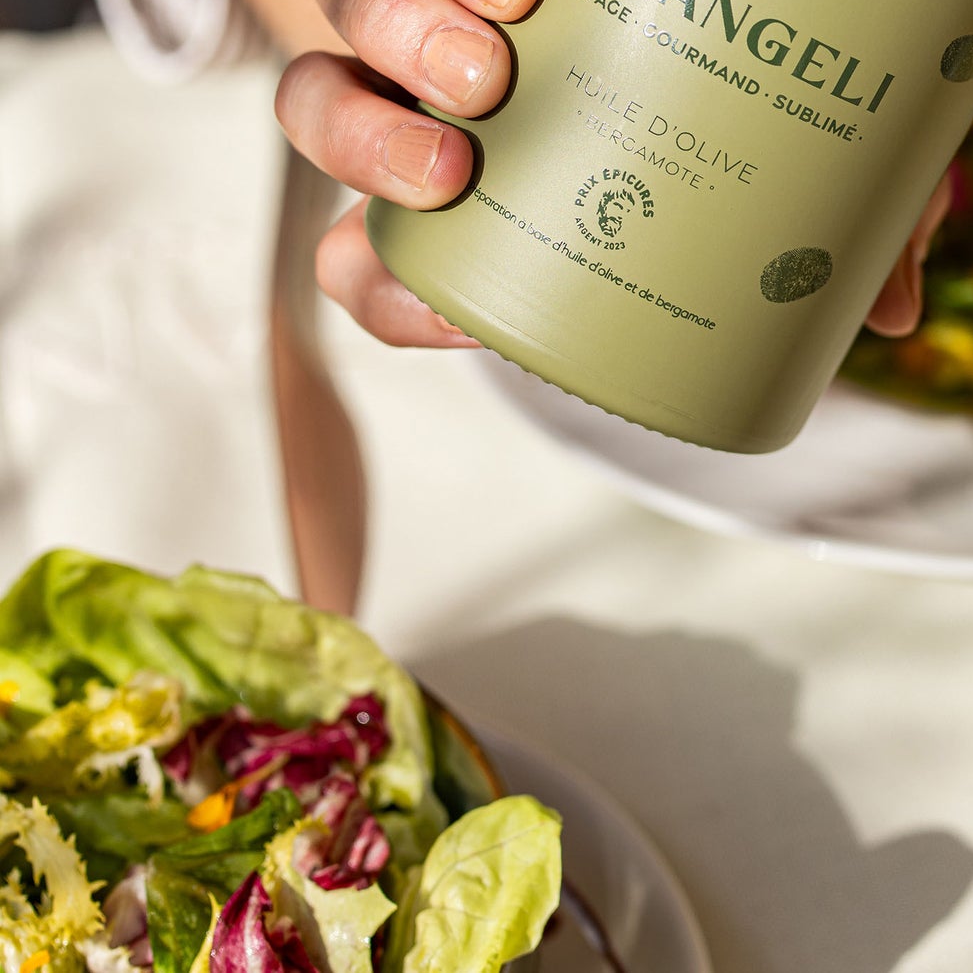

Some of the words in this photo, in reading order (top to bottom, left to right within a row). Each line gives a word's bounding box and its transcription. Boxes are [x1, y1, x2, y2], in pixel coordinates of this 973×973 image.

[565, 65, 643, 123] HUILE
[648, 115, 758, 185] D'OLIVE
[772, 94, 858, 142] SUBLIMÉ
[575, 175, 598, 207] PRIX
[575, 217, 602, 246] ARGENT
[604, 242, 625, 250] 2023
[518, 218, 526, 229] à
[526, 223, 551, 244] base
[588, 262, 623, 285] d'olive
[625, 282, 638, 294] et
[639, 288, 654, 302] de
[655, 294, 716, 330] bergamote
